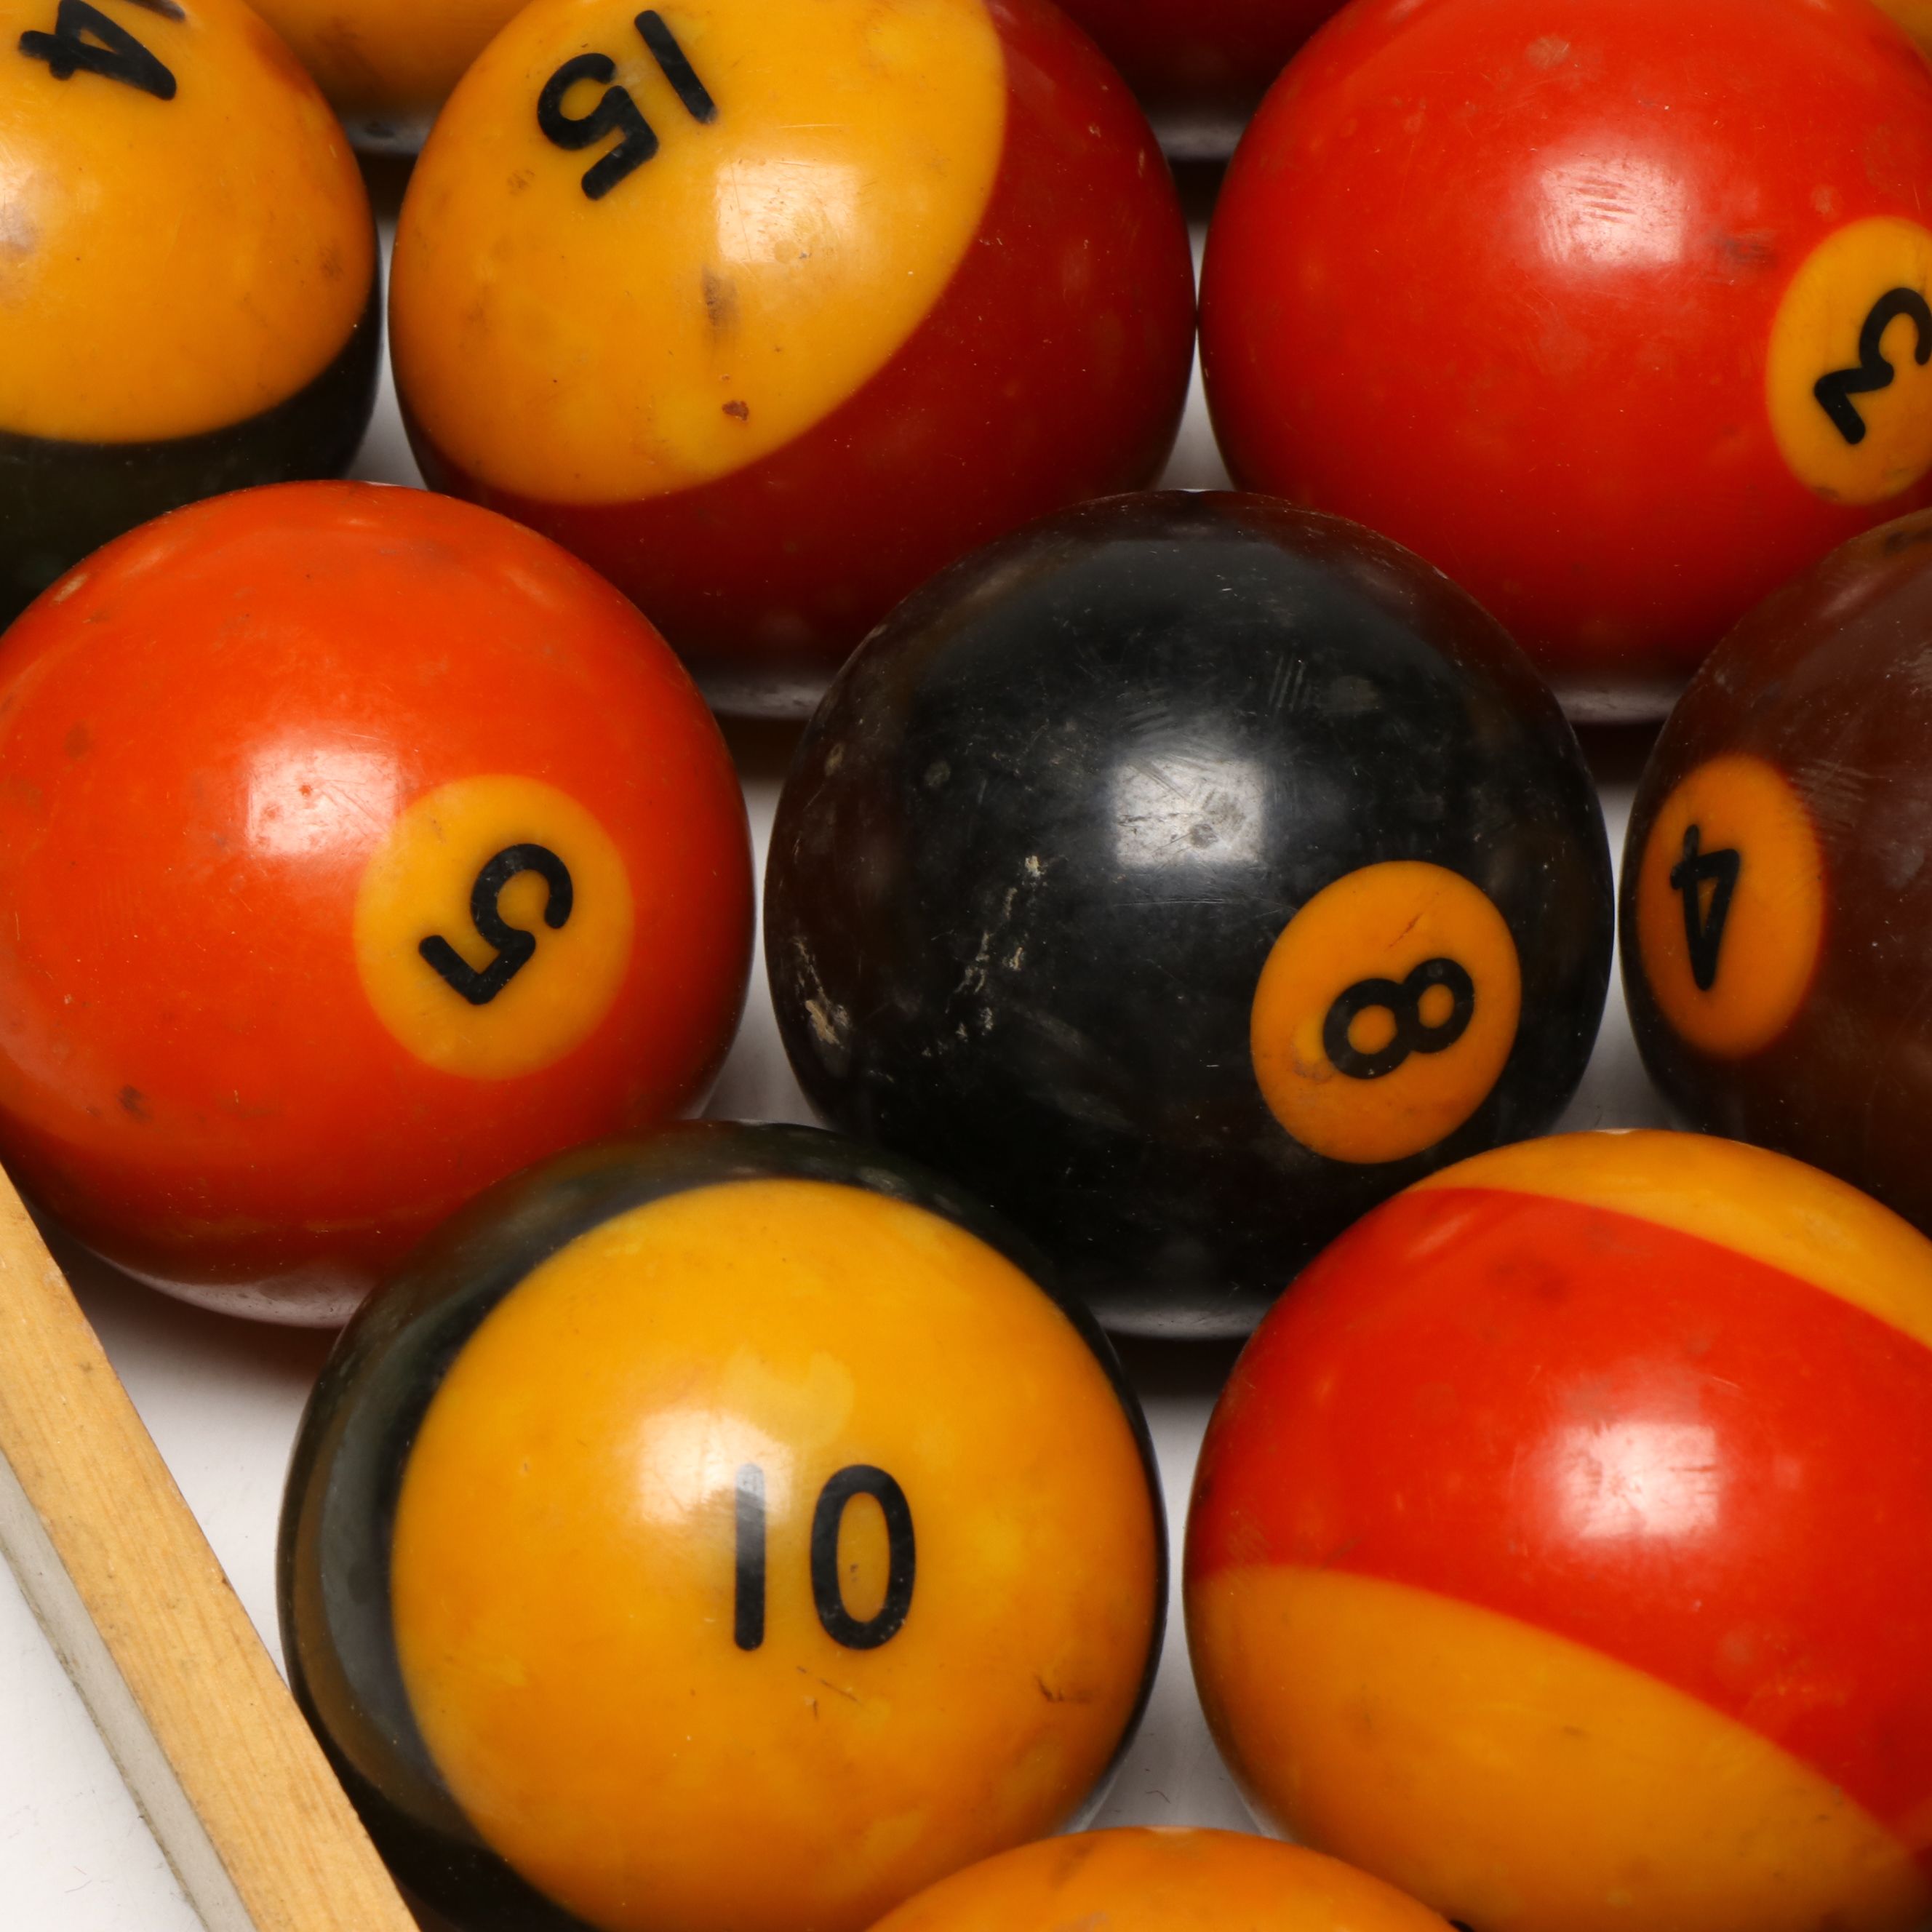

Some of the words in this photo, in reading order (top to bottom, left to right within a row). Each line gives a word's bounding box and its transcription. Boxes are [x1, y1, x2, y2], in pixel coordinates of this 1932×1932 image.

[537, 9, 716, 201] 15
[1813, 287, 1932, 444] 3
[419, 844, 573, 1005] 5
[1670, 824, 1741, 991] 4
[1323, 958, 1474, 1079] 8
[734, 1463, 916, 1651] 10
